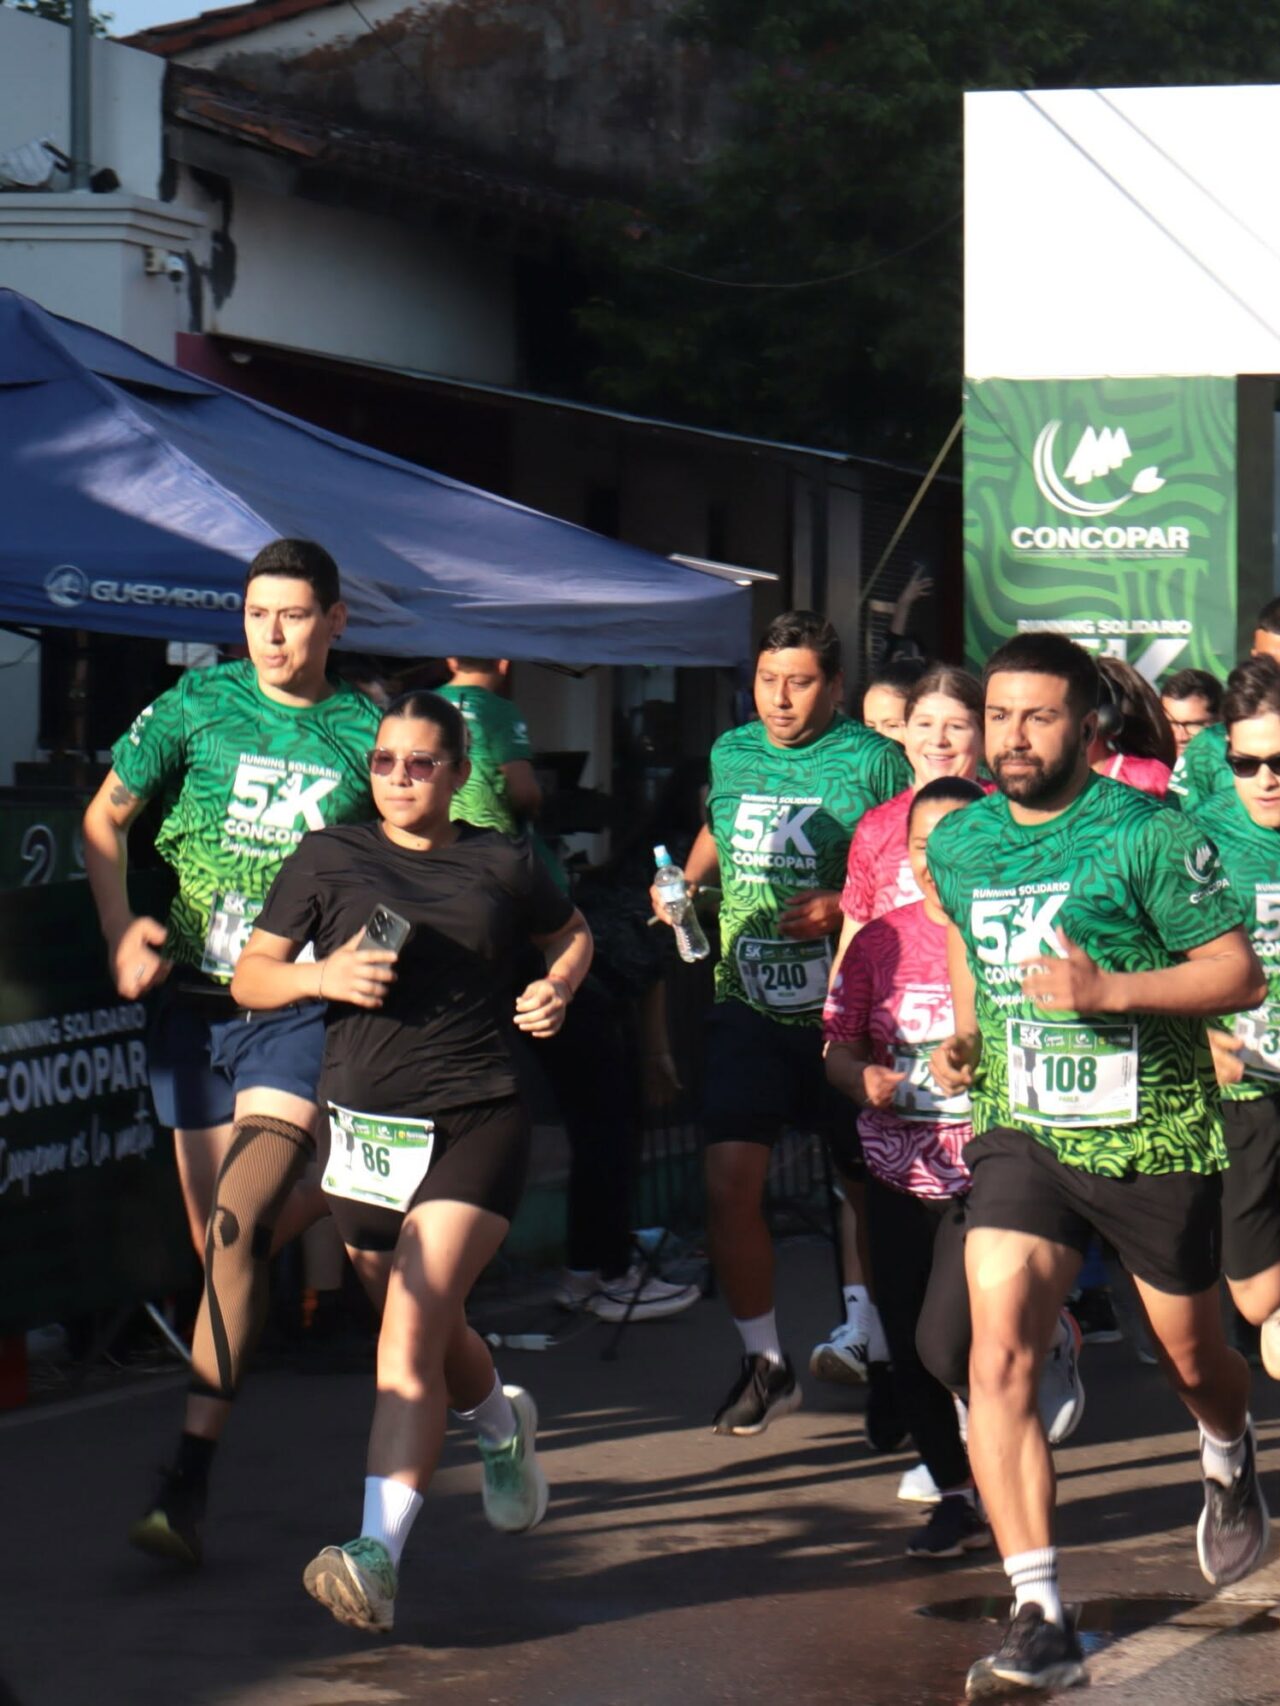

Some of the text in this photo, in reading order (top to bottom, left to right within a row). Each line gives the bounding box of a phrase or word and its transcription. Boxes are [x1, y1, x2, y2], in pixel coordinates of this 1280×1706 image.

[1011, 526, 1190, 549] CONCOPAR
[90, 580, 245, 612] GUEPARDO
[1017, 619, 1193, 634] RUNNING SOLIDARIO
[240, 753, 342, 779] RUNNING SOLIDARIO
[227, 764, 340, 832] 5K
[223, 819, 304, 844] CONCOP
[731, 802, 820, 857] 5K
[732, 852, 817, 869] CONCOPAR
[1018, 881, 1071, 896] SOLIDARIO
[971, 894, 1069, 966] 5K
[761, 963, 808, 990] 240
[1042, 1055, 1097, 1093] 108
[361, 1142, 390, 1177] 86
